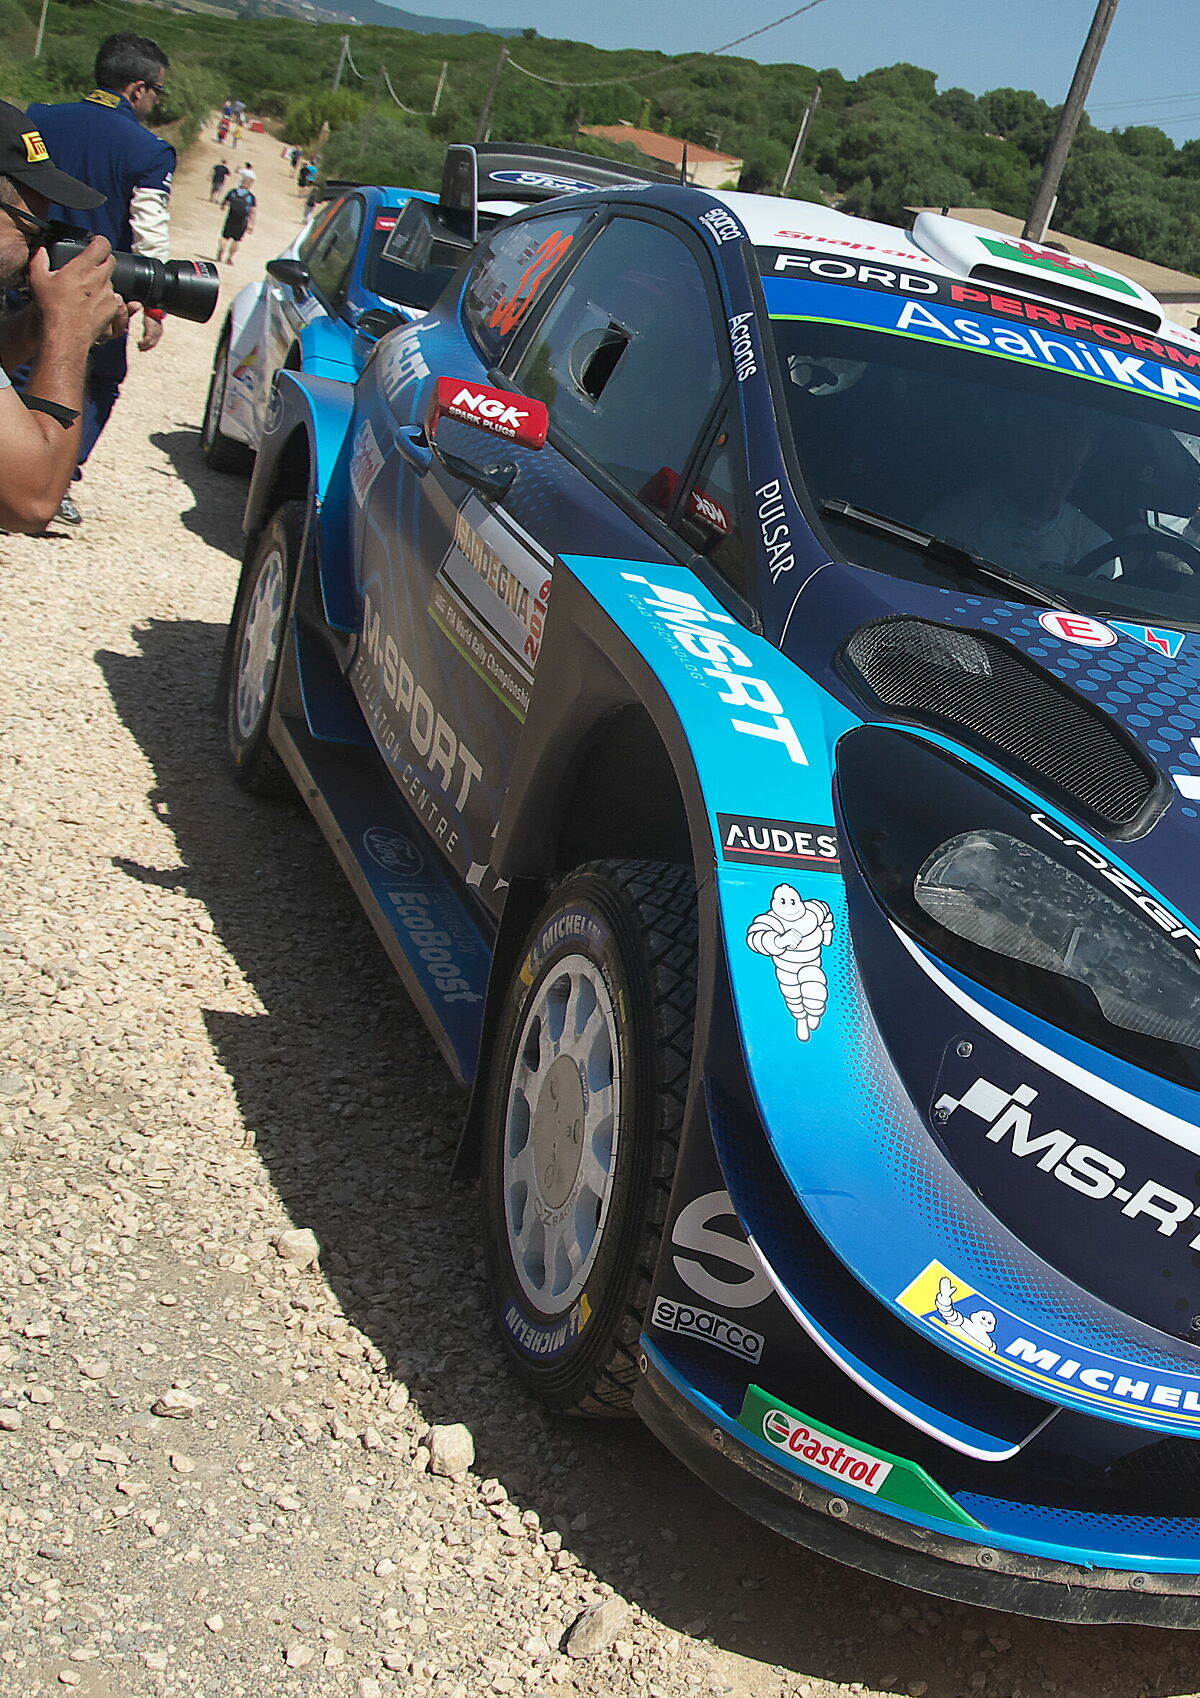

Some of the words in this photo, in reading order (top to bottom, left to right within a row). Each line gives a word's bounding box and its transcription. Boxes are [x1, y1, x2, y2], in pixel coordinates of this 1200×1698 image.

[774, 229, 931, 263] Snap-on
[773, 253, 940, 296] FORD
[727, 310, 758, 382] Acronis
[449, 406, 482, 429] SPARK
[483, 419, 516, 438] PLUGS
[452, 388, 529, 428] NGK
[755, 479, 796, 585] PULSAR
[456, 617, 473, 647] World
[523, 579, 552, 663] 2019
[625, 592, 652, 617] ROAD
[651, 621, 710, 689] TECHNOLOGY
[1055, 616, 1102, 642] E
[402, 764, 459, 852] CENTRE
[726, 824, 838, 858] AUDES
[505, 1306, 567, 1354] MICHELIN
[656, 1300, 761, 1354] sparco
[788, 1427, 882, 1488] Castrol
